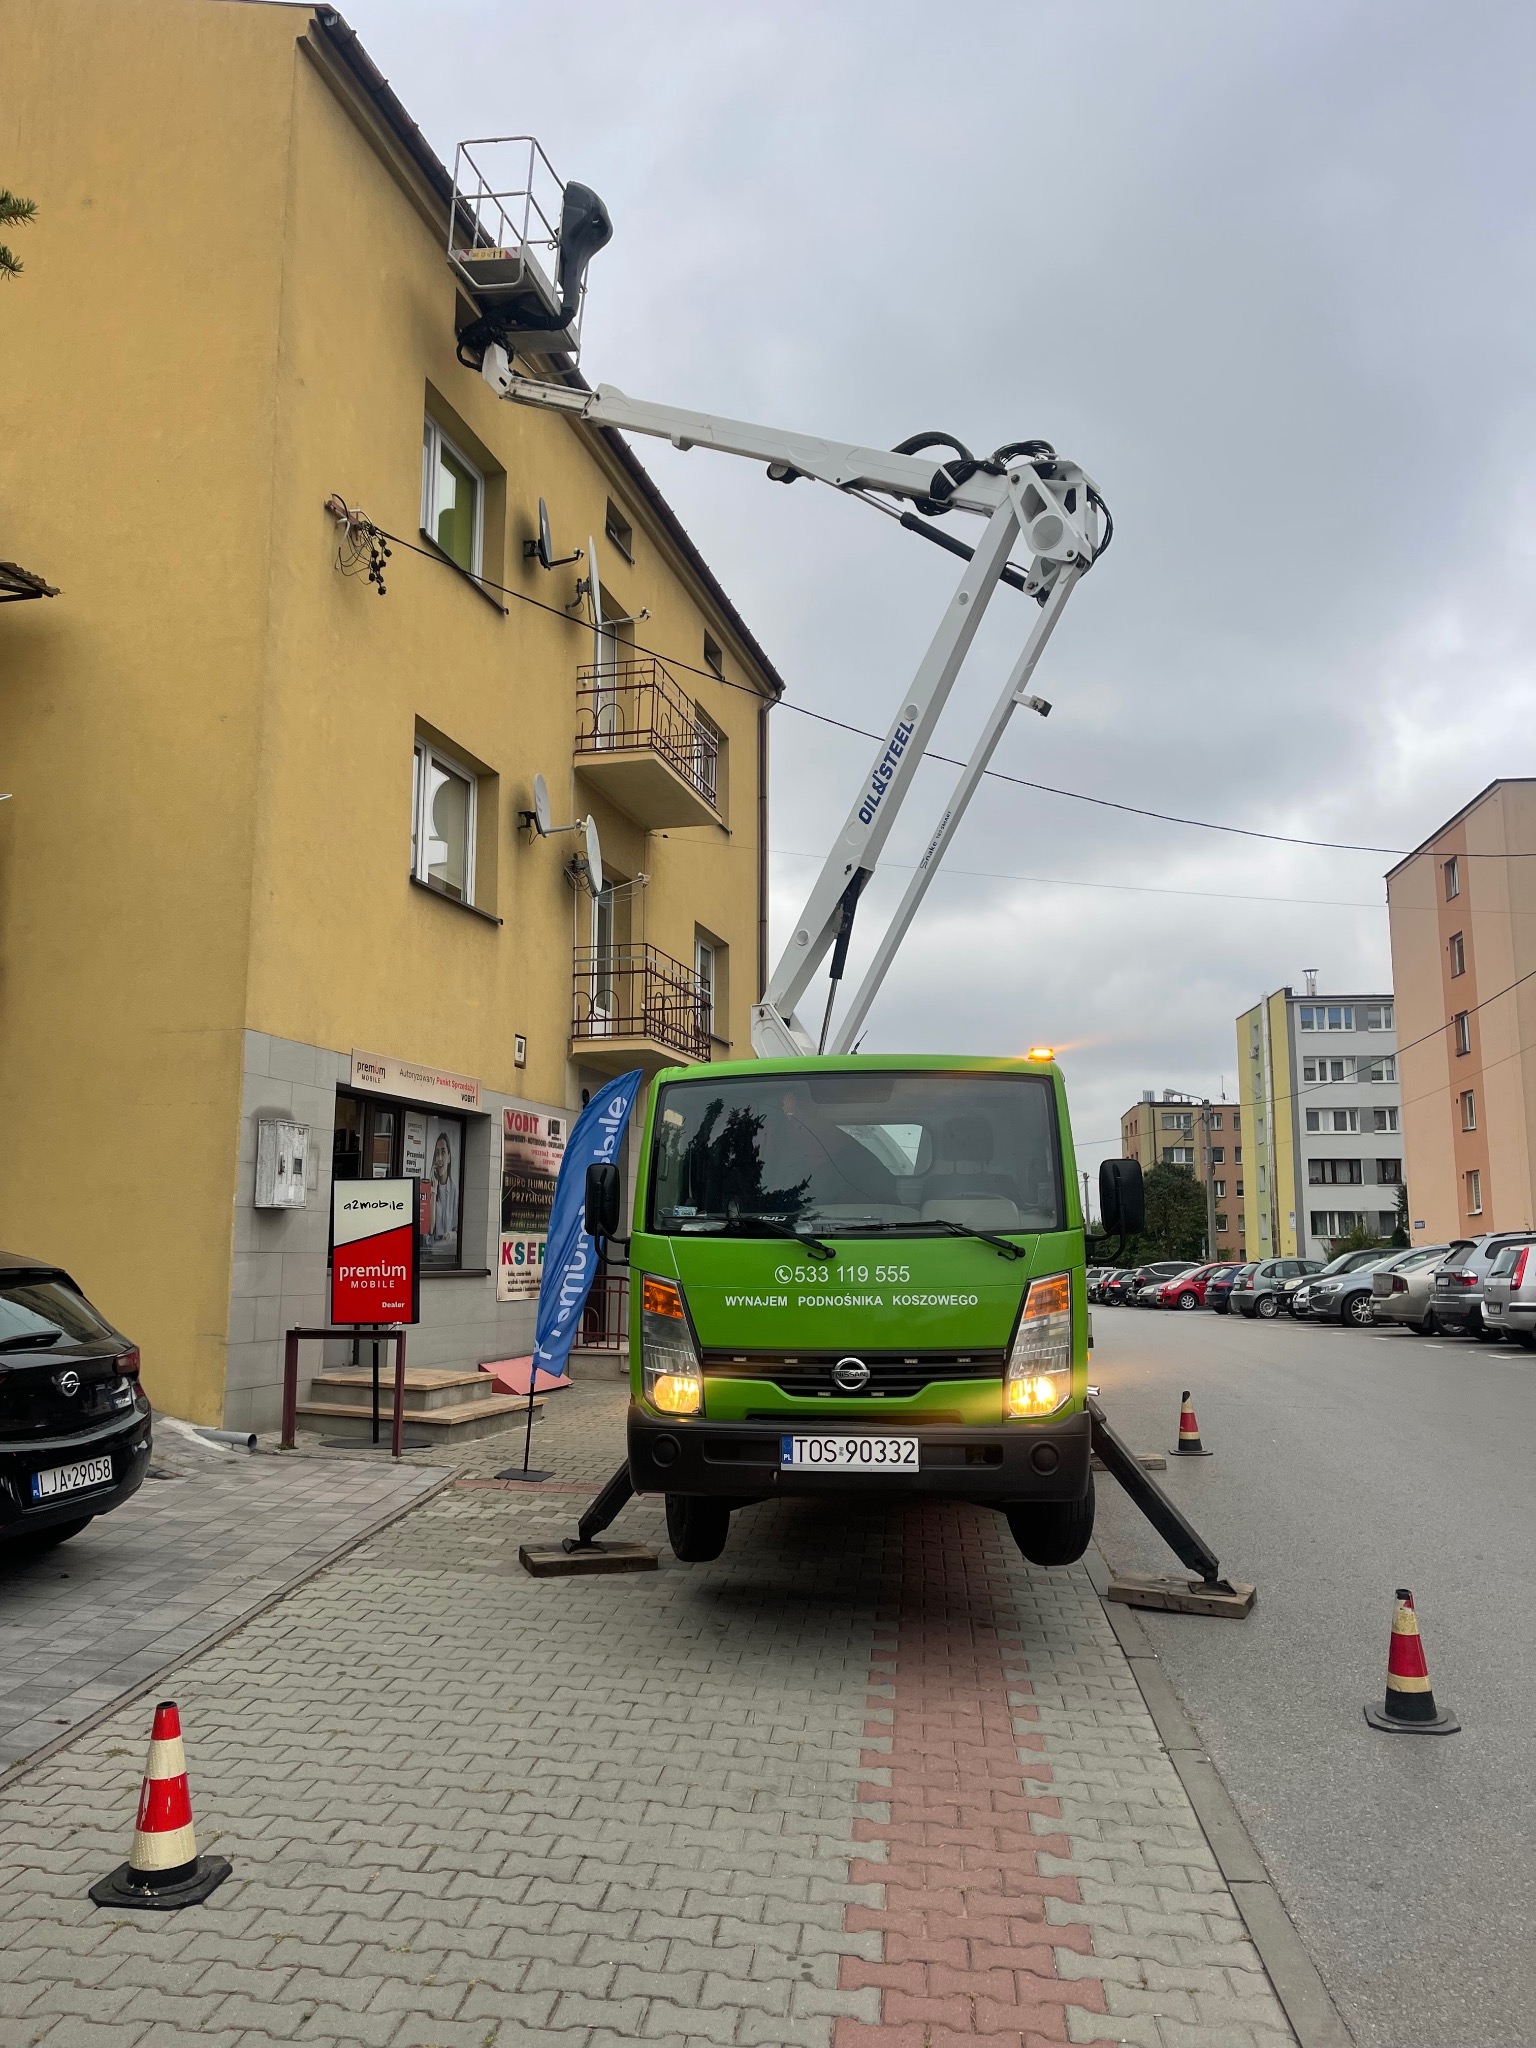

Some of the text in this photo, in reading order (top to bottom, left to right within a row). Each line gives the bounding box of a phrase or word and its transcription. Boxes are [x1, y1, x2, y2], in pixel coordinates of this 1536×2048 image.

[356, 1061, 386, 1080] premium
[361, 1073, 381, 1084] MOBILE
[399, 1068, 436, 1086] Autoryzowany
[435, 1076, 451, 1087] Punkt
[460, 1093, 476, 1104] VOBIT
[506, 1111, 539, 1135] VOBIT
[504, 1176, 526, 1188] BIURO
[343, 1200, 404, 1211] a2mobile
[339, 1260, 407, 1281] premium
[794, 1265, 910, 1283] 533 119 555
[350, 1280, 395, 1289] MOBILE
[725, 1293, 979, 1307] WYNAJEM PODNOŚNIKA KOSZOWEGO
[783, 1453, 792, 1461] PL
[795, 1439, 916, 1464] TOS 90332
[40, 1458, 111, 1495] LJA 29058
